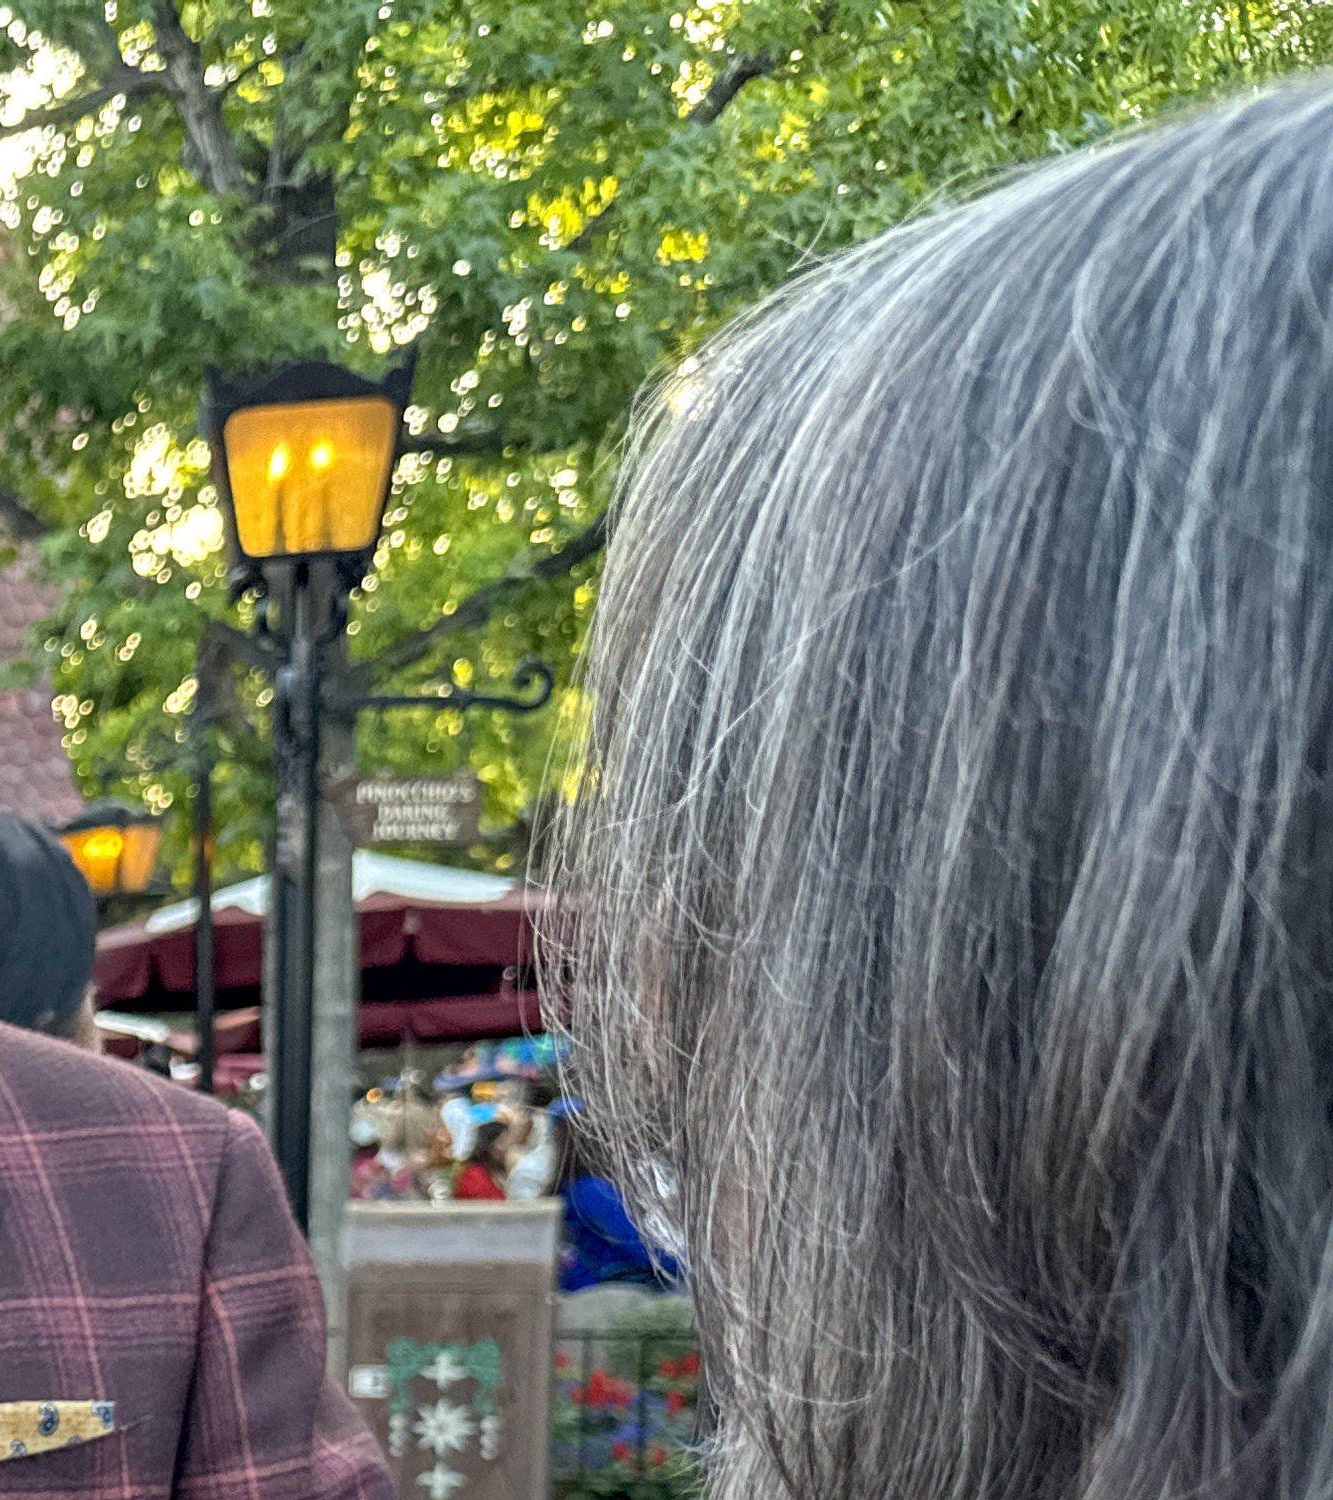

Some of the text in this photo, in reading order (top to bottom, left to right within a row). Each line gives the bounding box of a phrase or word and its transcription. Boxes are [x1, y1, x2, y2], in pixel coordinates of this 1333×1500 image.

[357, 781, 477, 804] PINOCCHIO'S
[378, 804, 450, 821] DARING
[373, 822, 461, 841] JOURNEY
